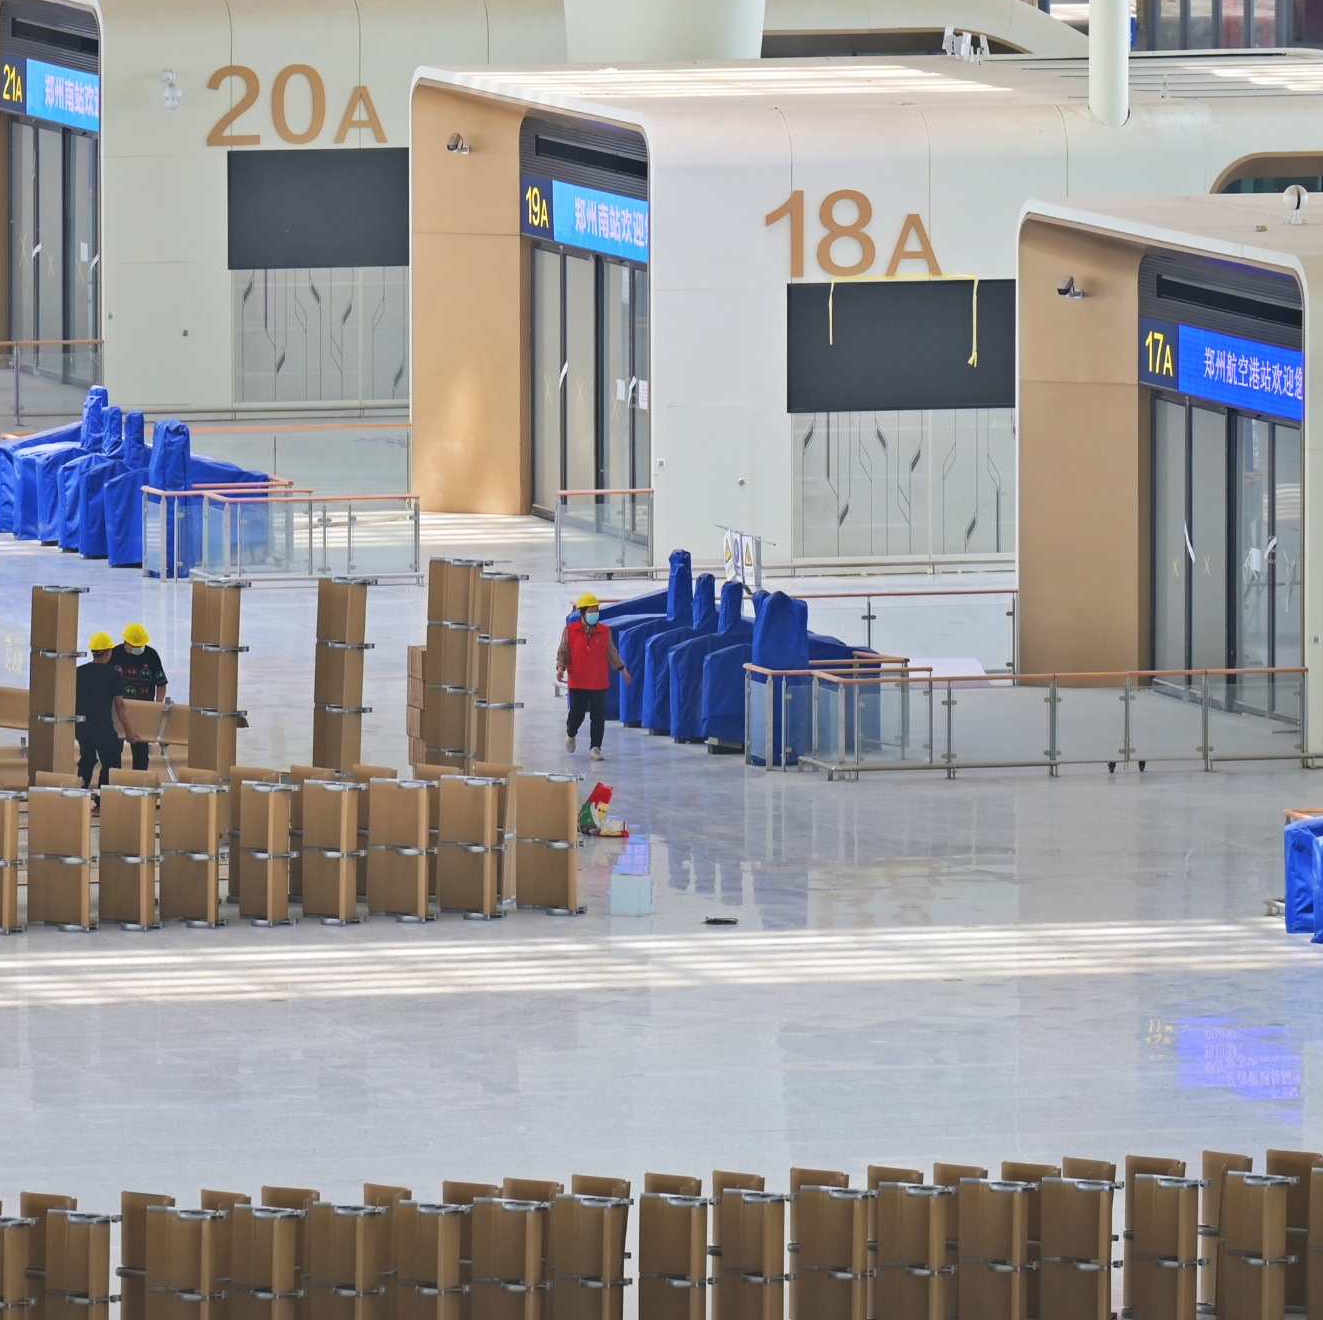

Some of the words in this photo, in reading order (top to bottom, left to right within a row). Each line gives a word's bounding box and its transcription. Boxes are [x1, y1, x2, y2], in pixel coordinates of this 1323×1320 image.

[2, 64, 23, 103] 21A
[206, 63, 388, 147] 20A
[525, 185, 549, 229] 19A
[574, 197, 648, 247] 郑州南站欢迎
[765, 188, 943, 278] 18A
[1145, 330, 1174, 378] 17A
[1203, 346, 1303, 401] 郑州航空港站欢迎您
